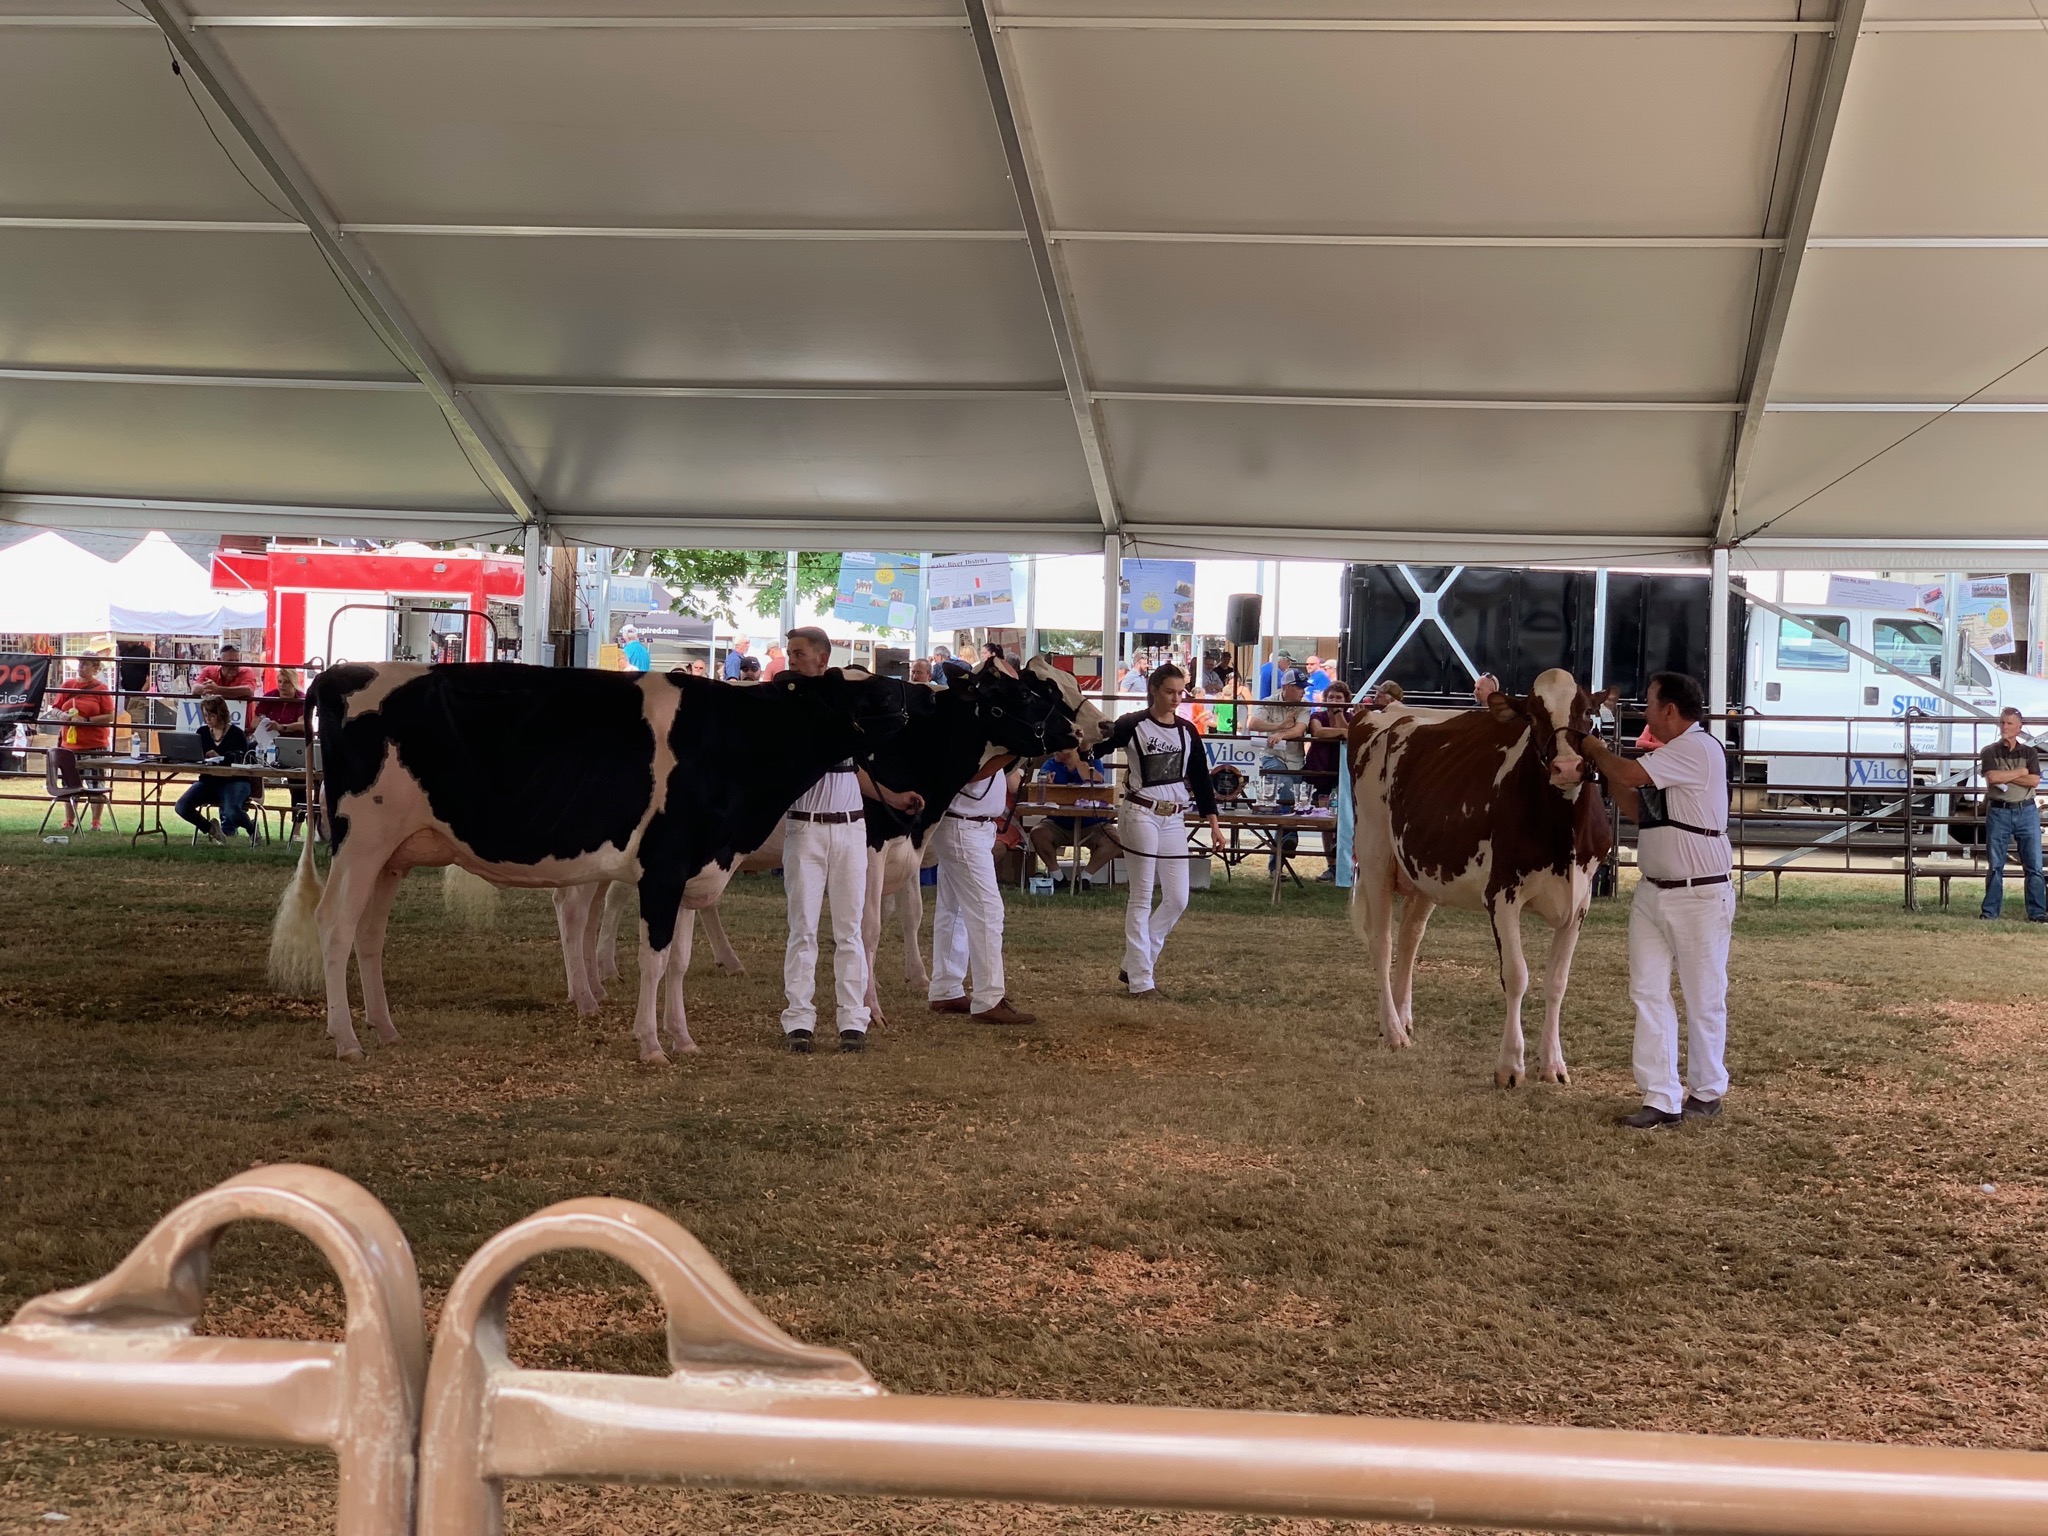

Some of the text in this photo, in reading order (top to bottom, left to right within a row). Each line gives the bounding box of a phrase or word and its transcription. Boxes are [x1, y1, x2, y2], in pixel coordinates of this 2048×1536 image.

[965, 557, 989, 566] District
[1204, 742, 1256, 767] Wilco
[1849, 760, 1908, 786] Wilco
